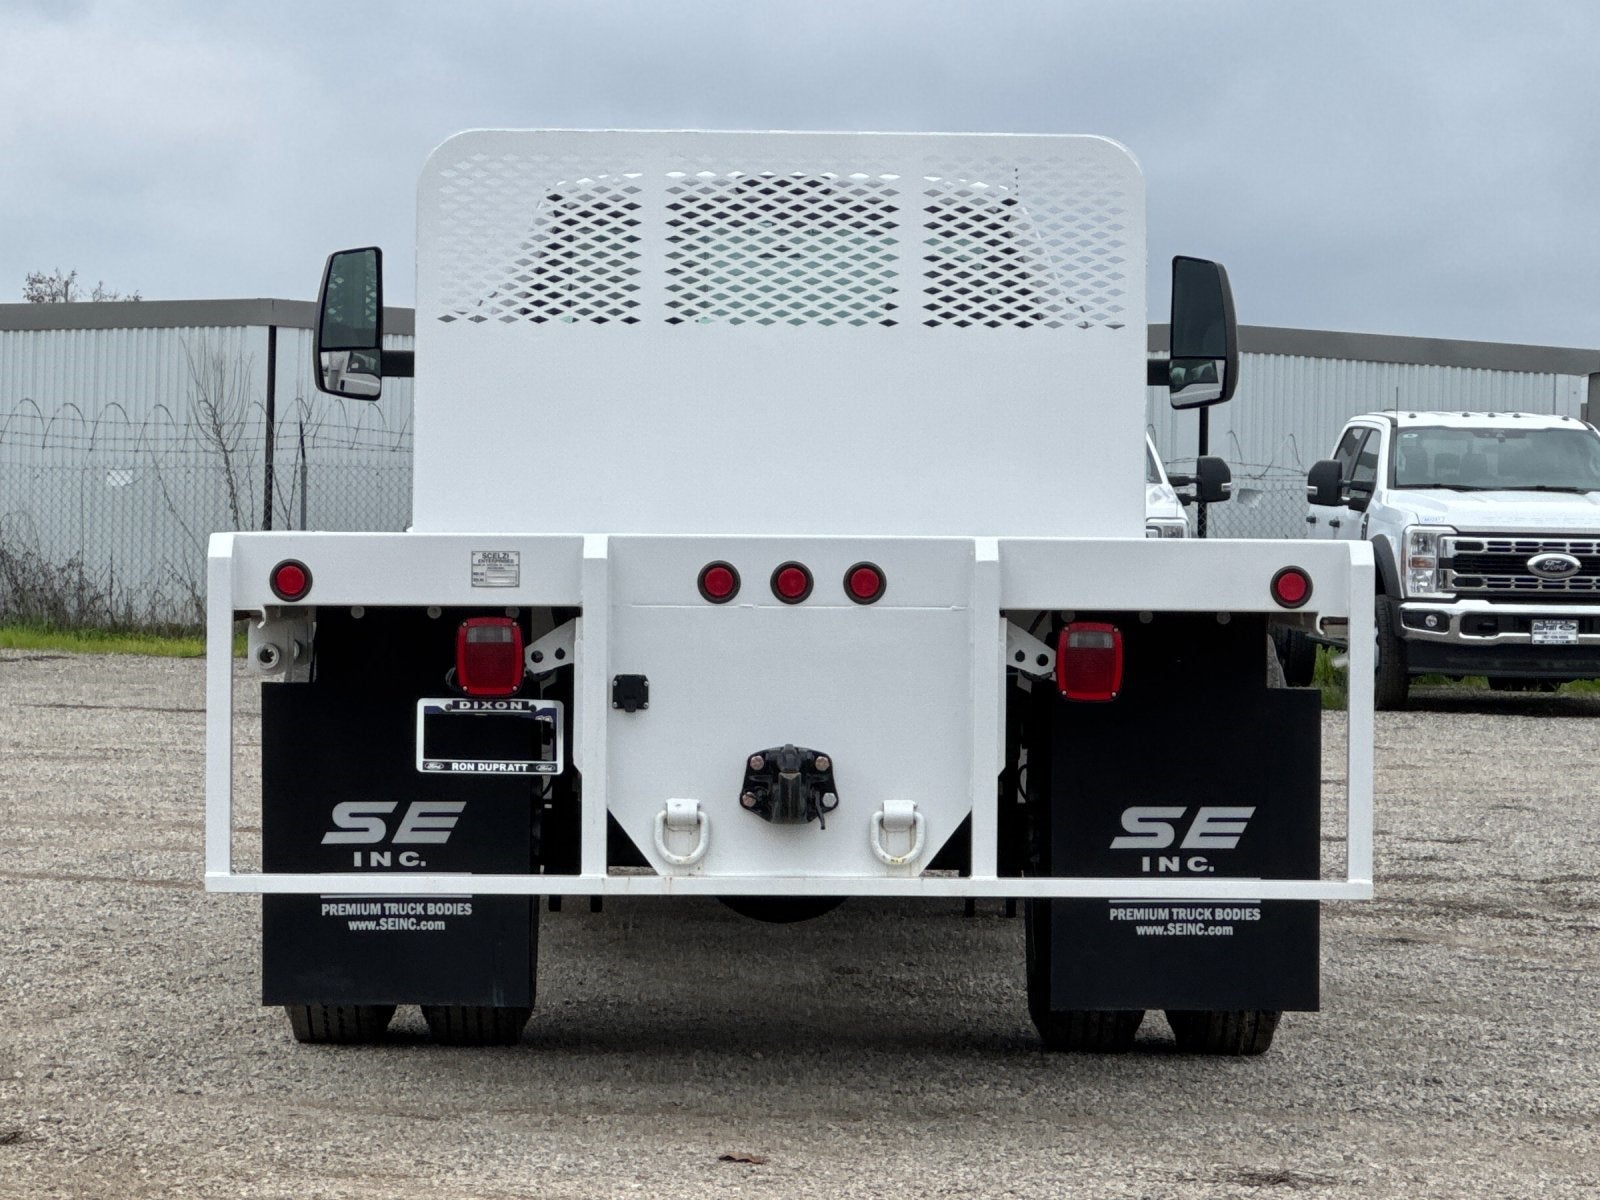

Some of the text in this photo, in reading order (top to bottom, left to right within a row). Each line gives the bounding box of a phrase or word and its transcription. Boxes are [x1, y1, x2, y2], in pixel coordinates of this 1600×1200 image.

[1542, 559, 1568, 571] Ford
[459, 701, 522, 709] DIXON
[452, 762, 529, 772] RON DUPRATT
[320, 801, 467, 844] SE
[1109, 806, 1257, 849] SE
[353, 851, 427, 867] INC.
[1142, 856, 1214, 872] INC.
[321, 903, 473, 916] PREMIUM TRUCK BODIES
[1109, 908, 1261, 921] PREMIUM TRUCK BODIES
[348, 917, 446, 931] www.SEINC.com
[1136, 922, 1234, 936] www.SEINC.com
